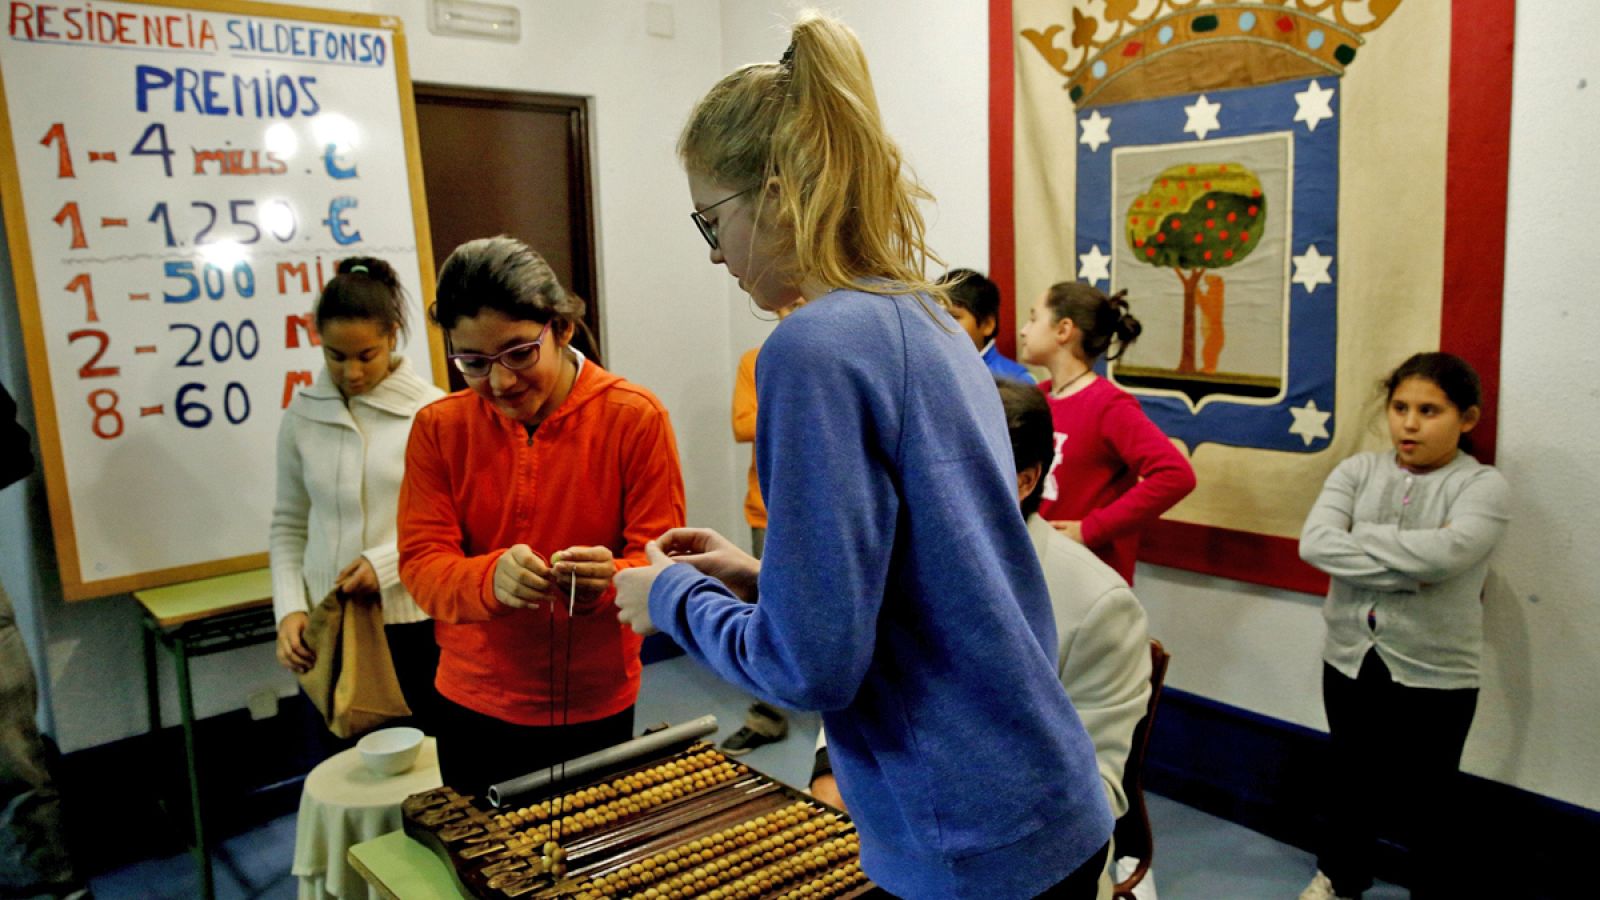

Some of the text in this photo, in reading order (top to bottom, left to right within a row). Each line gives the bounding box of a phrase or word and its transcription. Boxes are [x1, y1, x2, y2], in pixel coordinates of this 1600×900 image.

[136, 64, 320, 118] PREMIOS
[40, 122, 76, 179] 1
[130, 122, 175, 177] 4
[53, 201, 88, 250] 1
[322, 196, 363, 246] €
[65, 272, 99, 322] 1
[163, 260, 256, 303] 500
[68, 329, 120, 379] 2
[169, 319, 260, 368] 200
[87, 388, 124, 440] 8
[174, 381, 250, 429] 60
